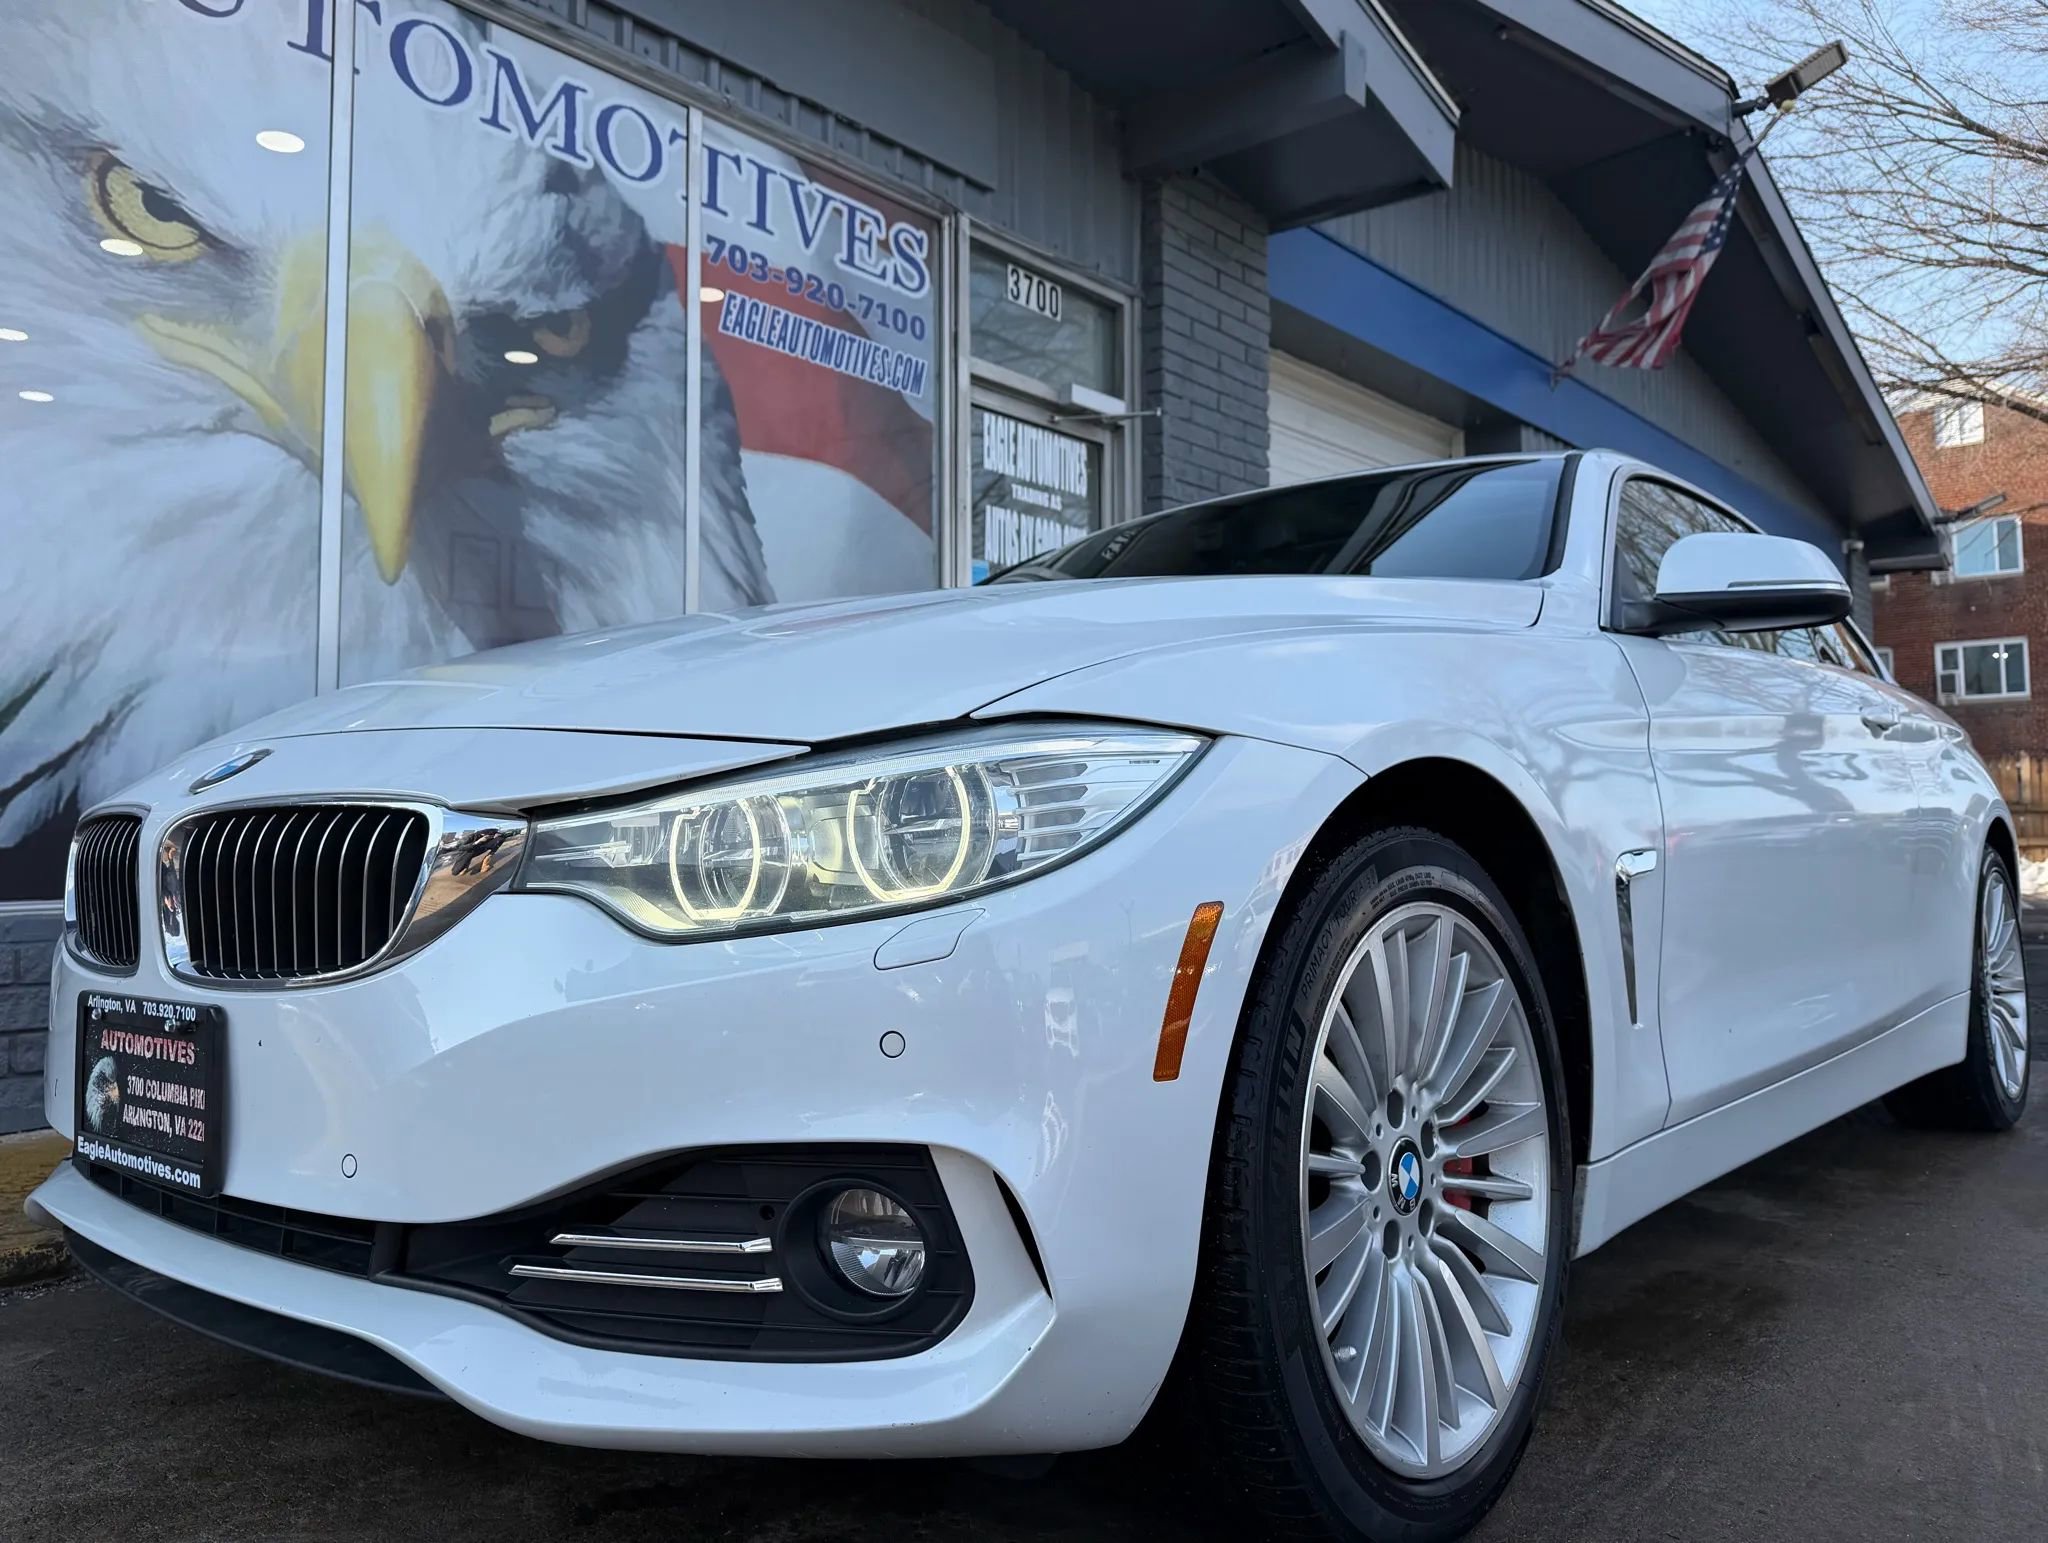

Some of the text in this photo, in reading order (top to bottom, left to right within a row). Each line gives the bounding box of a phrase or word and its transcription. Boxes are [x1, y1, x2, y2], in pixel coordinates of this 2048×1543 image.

[178, 0, 927, 294] TOMOTIVES
[706, 234, 926, 341] 703-920-7100
[1010, 268, 1060, 319] 3700
[720, 291, 926, 397] EAGLEAUTOMOTIVES.COM
[983, 411, 1088, 498] EAGLE AUTOMOTIVES
[125, 1000, 136, 1014] VA
[142, 1002, 196, 1022] 703.920.7100
[101, 1029, 195, 1065] AUTOMOTIVES
[127, 1075, 144, 1096] 3700
[145, 1079, 188, 1106] COLUMBIA
[174, 1117, 187, 1136] VA
[77, 1136, 201, 1189] EagleAutomotives.com
